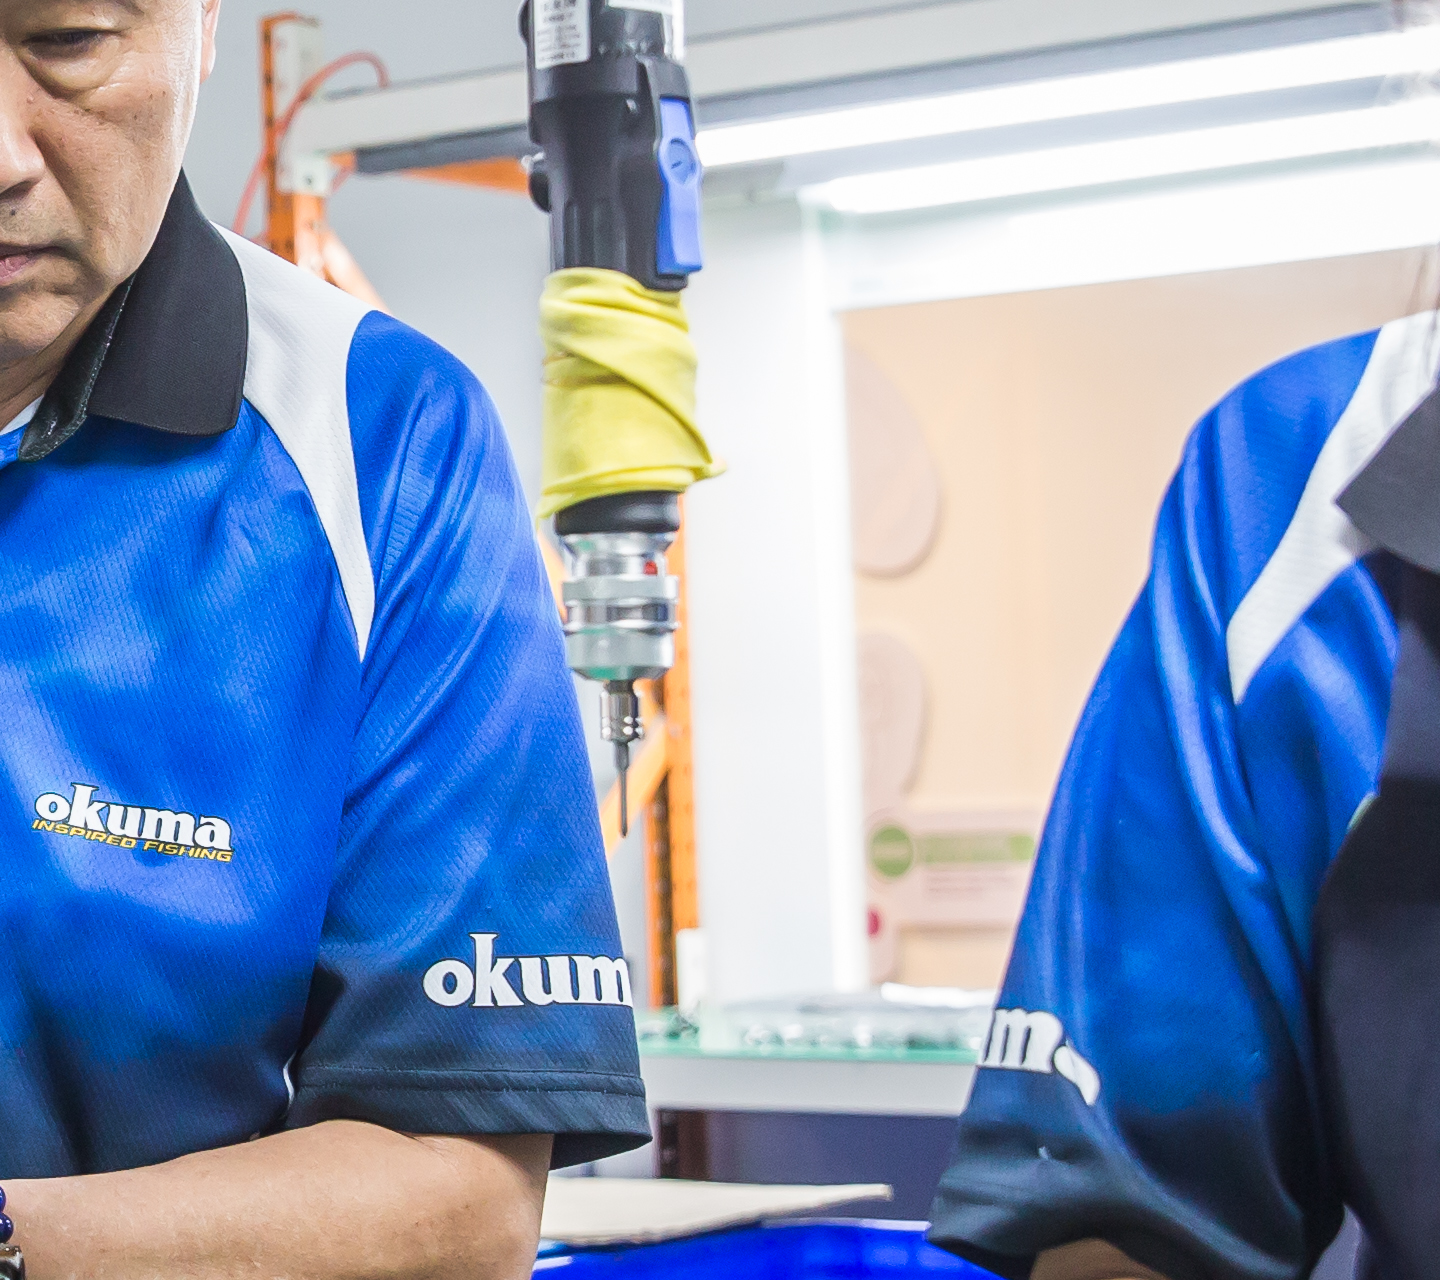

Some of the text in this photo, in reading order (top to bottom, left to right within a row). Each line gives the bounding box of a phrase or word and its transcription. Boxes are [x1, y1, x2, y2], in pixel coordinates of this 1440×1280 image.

[31, 818, 235, 864] INSPIRED FISHING
[34, 781, 233, 851] okuma
[422, 931, 634, 1008] okum
